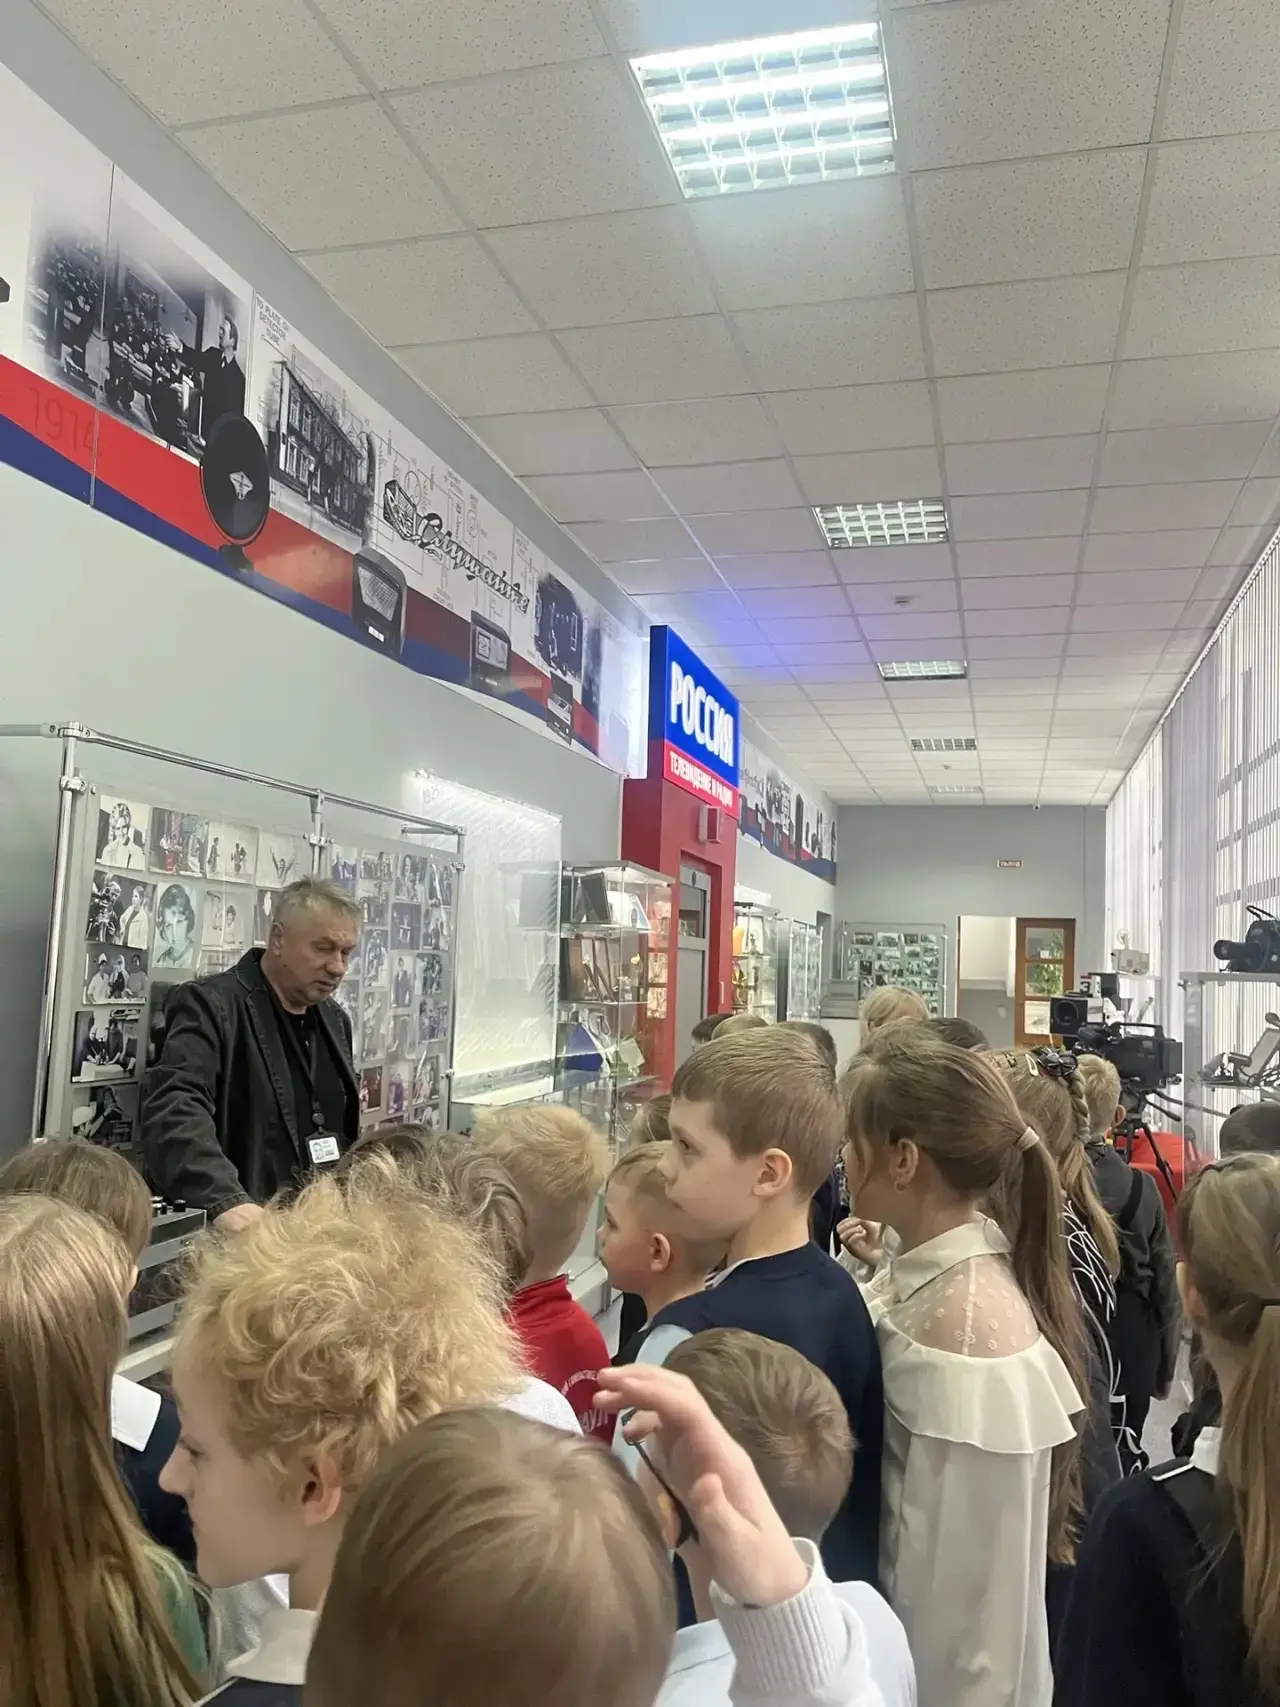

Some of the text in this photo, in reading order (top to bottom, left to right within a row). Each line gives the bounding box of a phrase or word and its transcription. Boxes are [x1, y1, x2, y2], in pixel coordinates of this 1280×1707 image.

[670, 660, 734, 768] РОССИЯ
[669, 750, 712, 796] ТЕЛЕВИДЕНИЕ
[1080, 981, 1091, 994] 3
